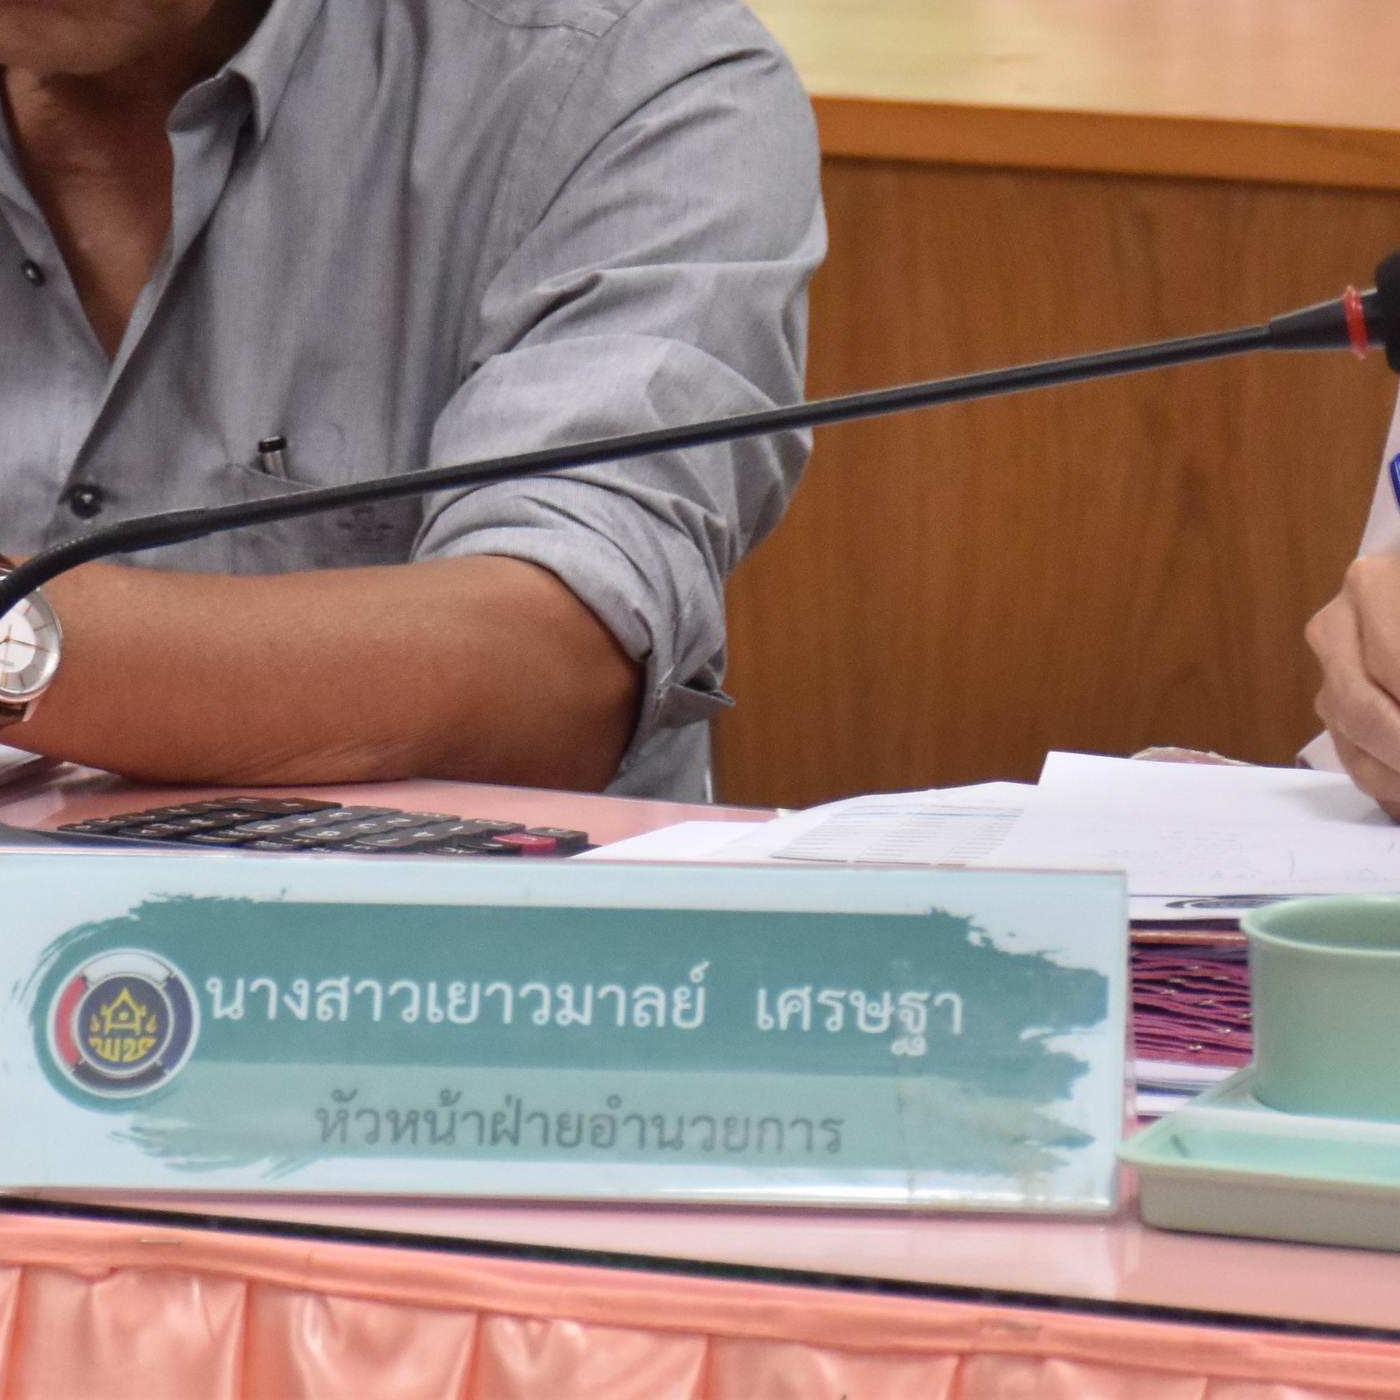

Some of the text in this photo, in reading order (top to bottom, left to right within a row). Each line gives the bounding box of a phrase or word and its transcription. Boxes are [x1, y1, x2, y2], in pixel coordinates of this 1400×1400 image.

[205, 960, 964, 1057] นางสาวเยาวมาลย์ เศรษฐา
[315, 1088, 845, 1156] หัวหน้าฝ่ายอำนวยการ
